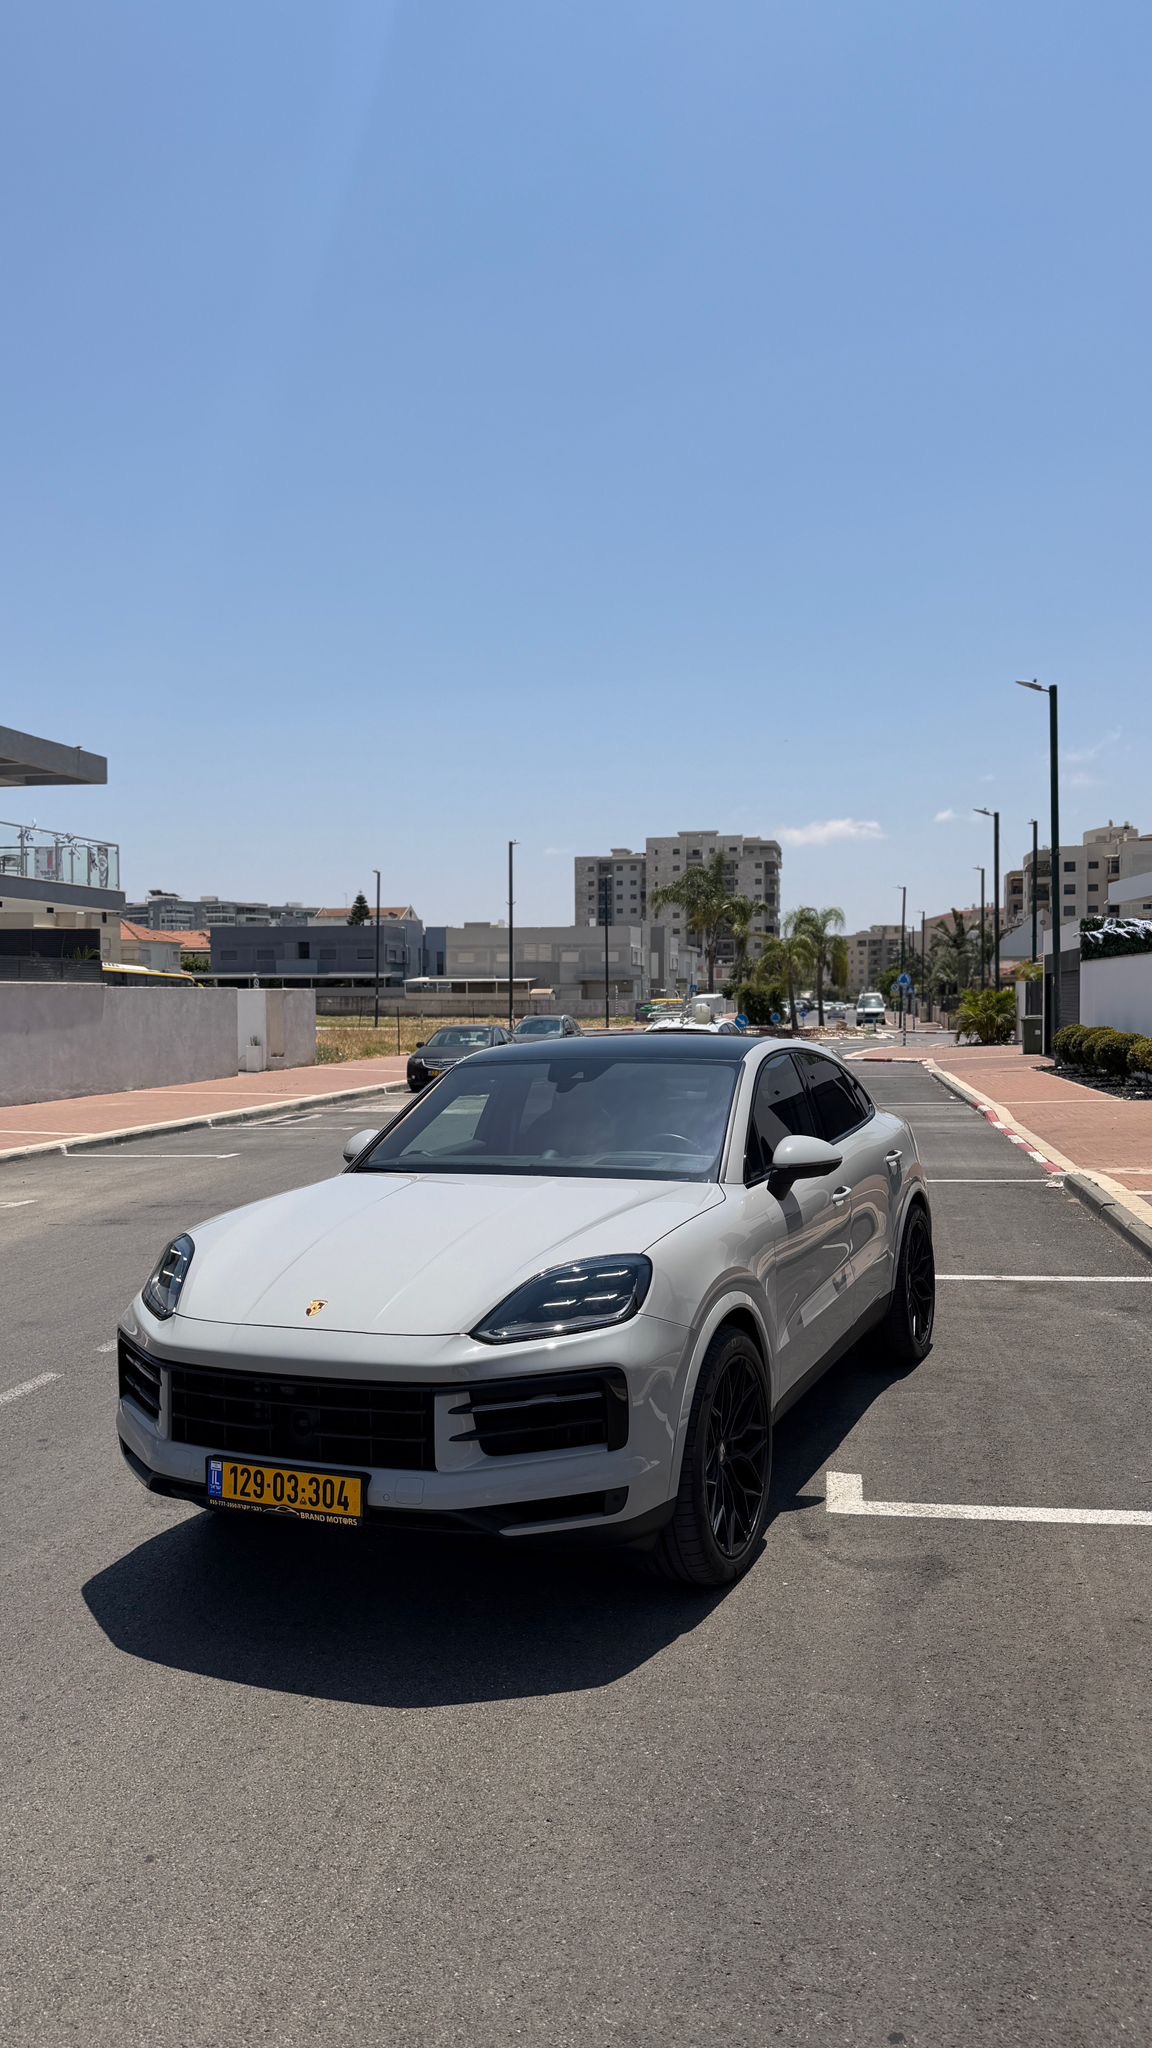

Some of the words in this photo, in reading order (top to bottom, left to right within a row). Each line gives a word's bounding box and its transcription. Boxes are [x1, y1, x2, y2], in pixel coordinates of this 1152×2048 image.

[211, 1470, 220, 1485] IL
[300, 1511, 326, 1522] BRAND
[326, 1515, 358, 1526] MOTORS
